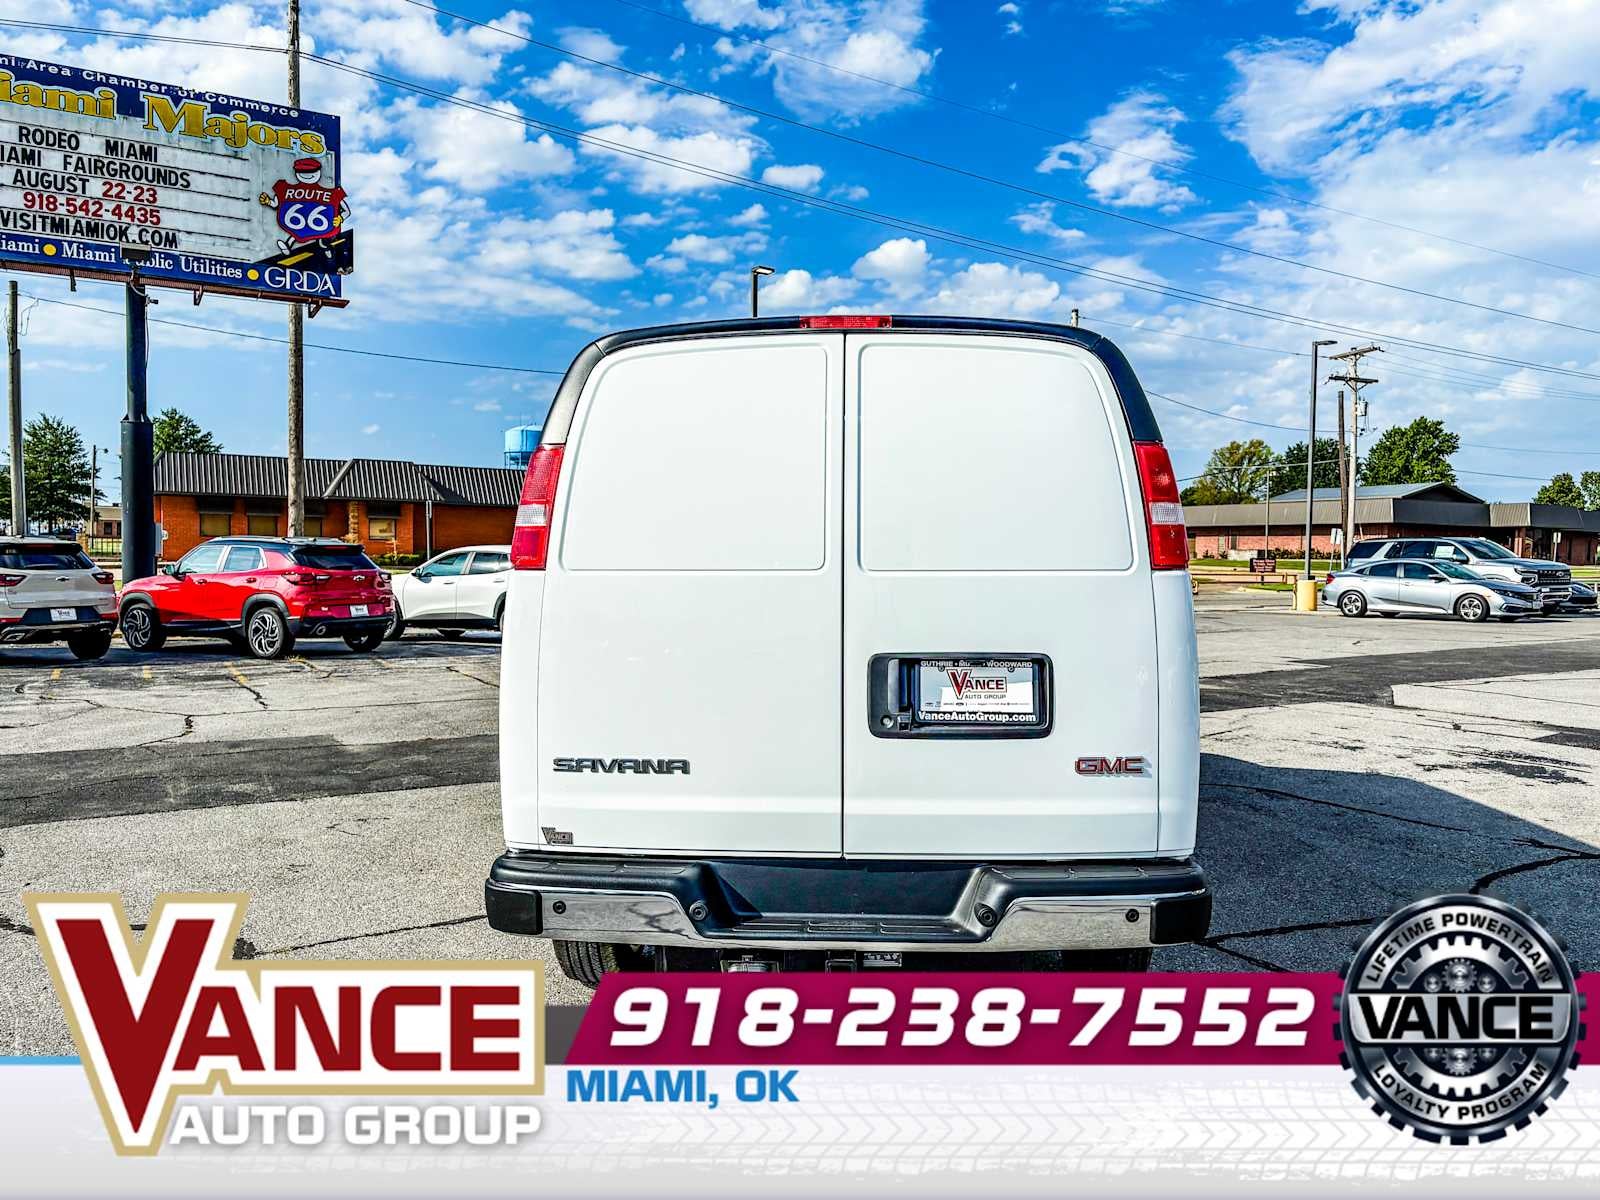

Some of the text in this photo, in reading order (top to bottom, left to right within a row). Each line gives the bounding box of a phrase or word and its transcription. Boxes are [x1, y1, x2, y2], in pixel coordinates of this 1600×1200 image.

[26, 59, 72, 77] Area
[82, 70, 169, 93] Chamber
[205, 92, 299, 118] Commerce
[143, 95, 325, 155] Majors
[18, 125, 158, 163] RODEO MIAMI
[12, 168, 158, 204] AUGUST 22-23
[63, 154, 191, 189] FAIRGROUNDS
[23, 191, 161, 226] 918-542-4435
[285, 188, 332, 202] ROUTE
[0, 209, 178, 249] VISITMIAMIOK.COM
[284, 203, 329, 231] 66
[61, 241, 116, 263] Miami
[181, 256, 243, 279] Utilities
[264, 266, 336, 295] GRDA
[987, 660, 1033, 668] WOODWARD
[948, 670, 1005, 698] VANCE
[918, 711, 1037, 722] VanceAutoGroup.com
[553, 757, 690, 774] SAVANA
[1075, 756, 1145, 775] GMC
